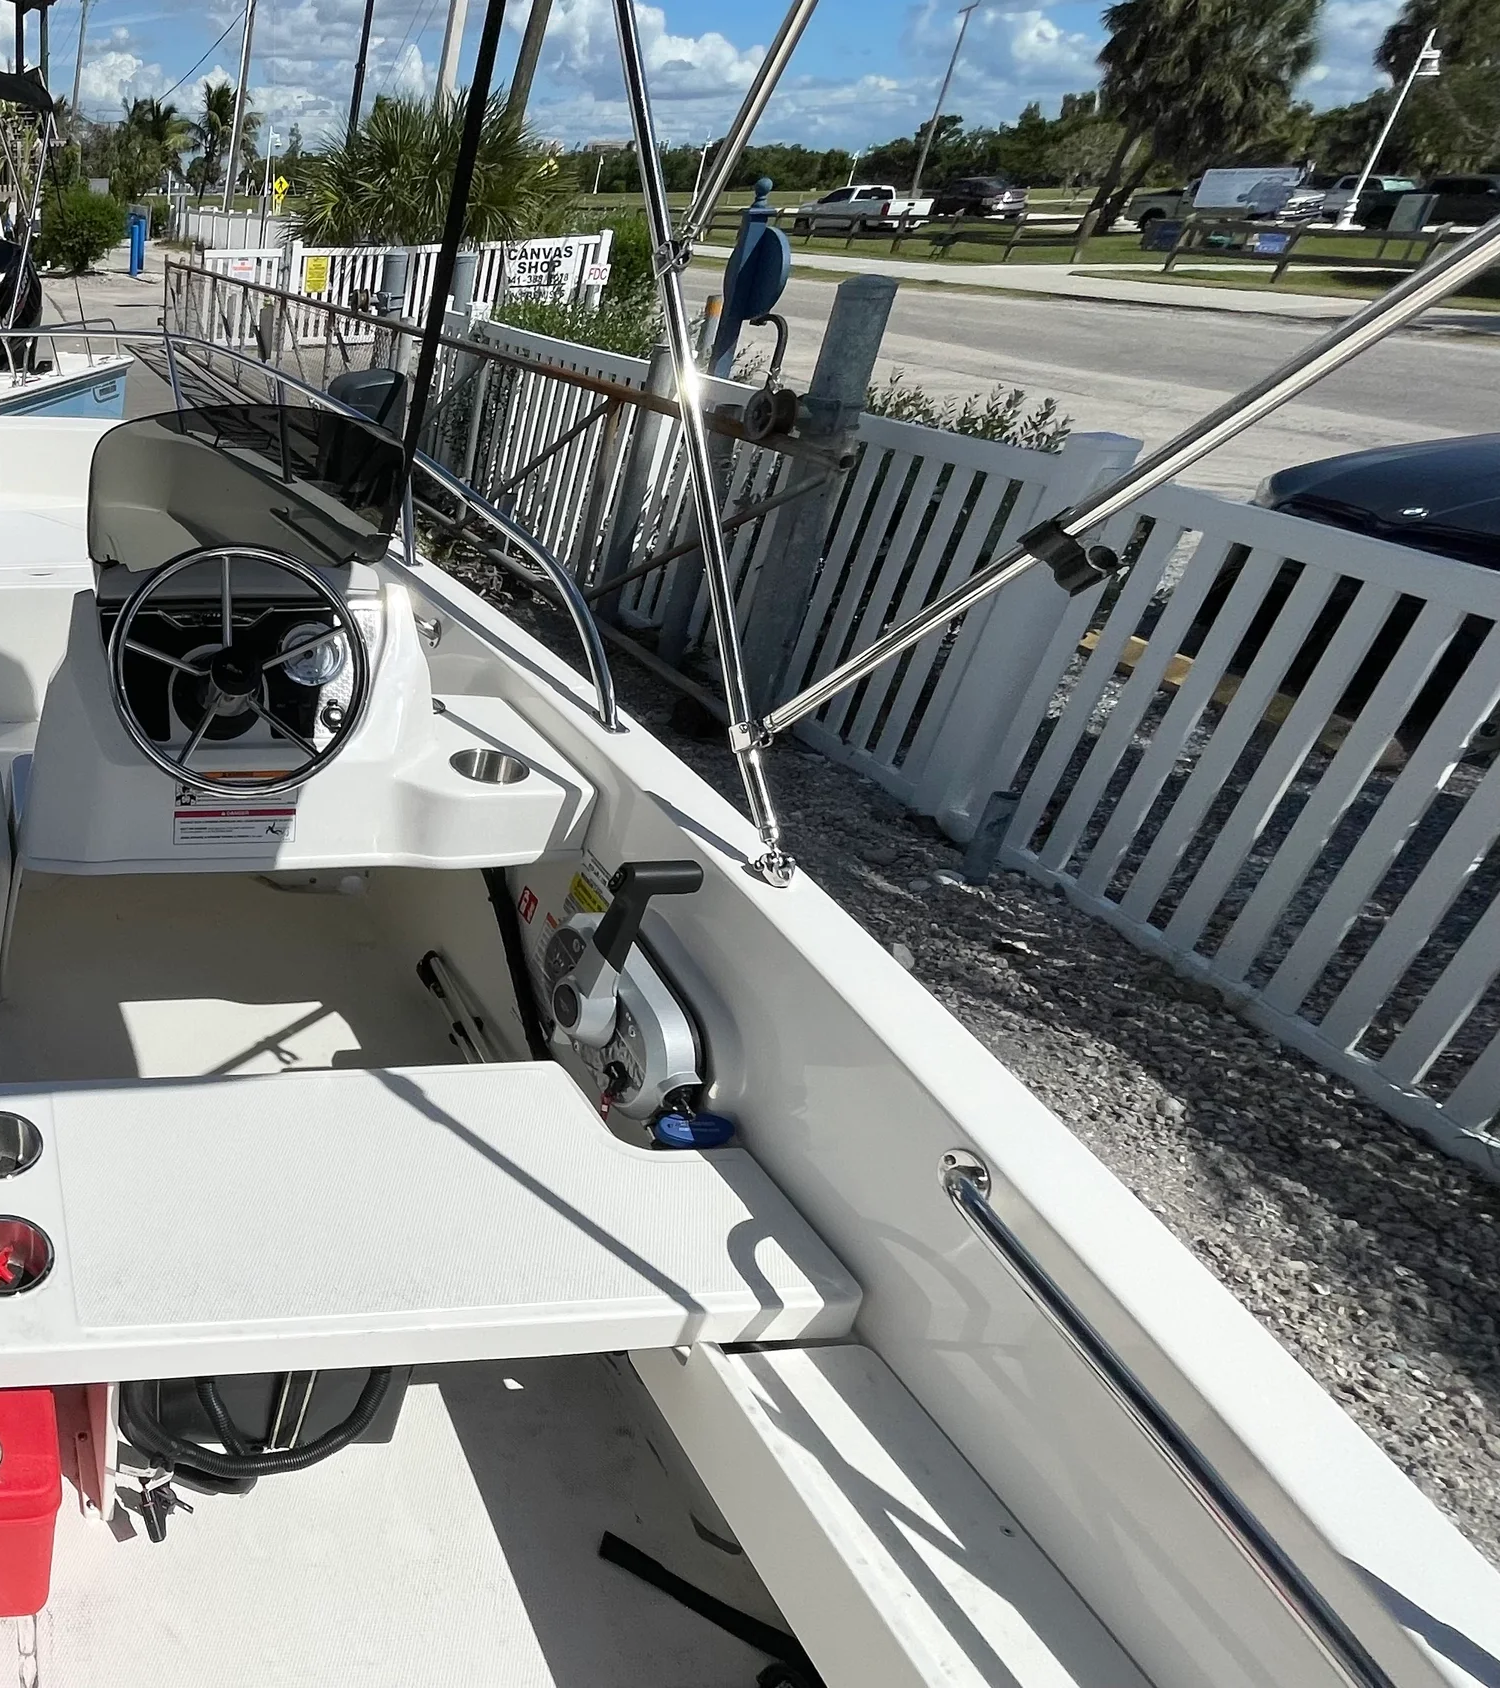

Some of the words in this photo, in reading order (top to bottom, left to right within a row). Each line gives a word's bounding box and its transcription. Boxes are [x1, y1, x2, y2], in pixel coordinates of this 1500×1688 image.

[508, 246, 573, 261] CANVAS
[517, 260, 562, 274] SHOP
[588, 268, 608, 280] FDC
